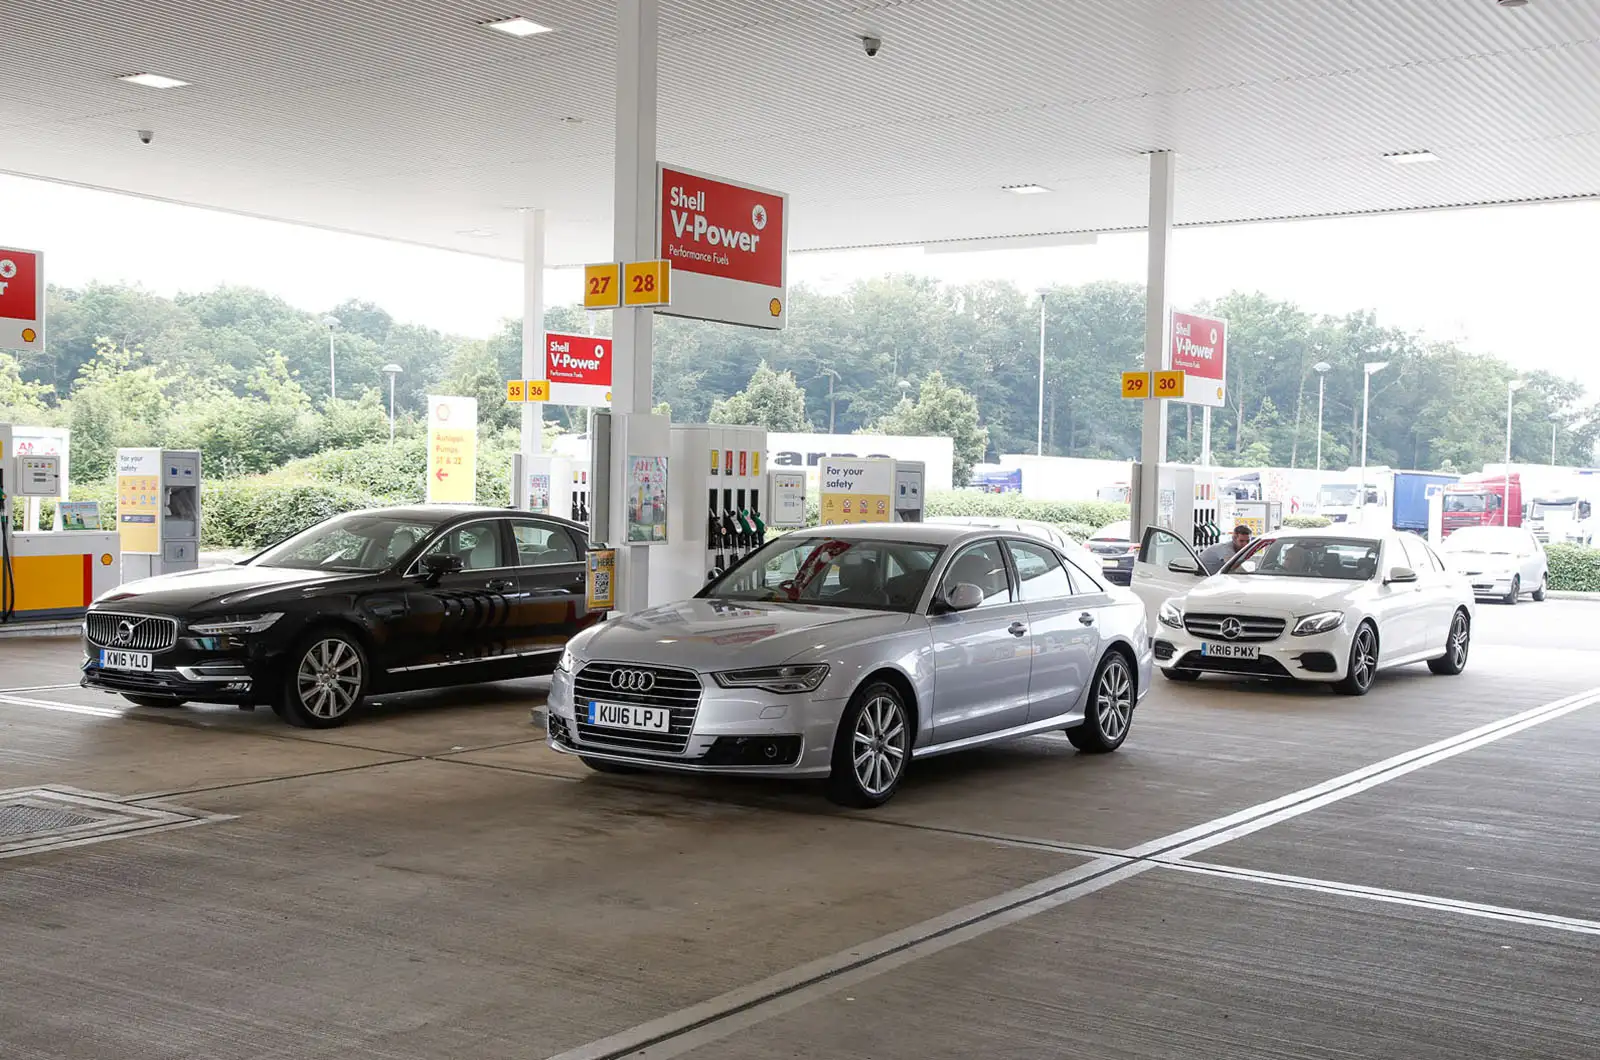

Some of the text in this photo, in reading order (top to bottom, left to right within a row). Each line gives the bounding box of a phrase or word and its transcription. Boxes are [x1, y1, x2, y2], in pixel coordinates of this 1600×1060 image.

[669, 186, 705, 212] Shell
[669, 209, 760, 253] V-Power
[668, 243, 730, 265] Performance Fuels
[589, 276, 611, 295] 27
[632, 274, 655, 293] 28
[1175, 321, 1191, 337] Shell
[550, 341, 570, 353] Shell
[1175, 336, 1215, 360] V-Power
[550, 353, 600, 370] V-Power
[509, 386, 521, 396] 35
[531, 386, 543, 396] 36
[1126, 379, 1143, 391] 29
[1159, 378, 1176, 390] 30
[826, 466, 864, 477] For your
[826, 480, 854, 490] safety
[1209, 644, 1254, 657] KR16 PMX
[107, 653, 148, 668] KW16 YLO
[599, 705, 664, 728] KU16 LPJ
